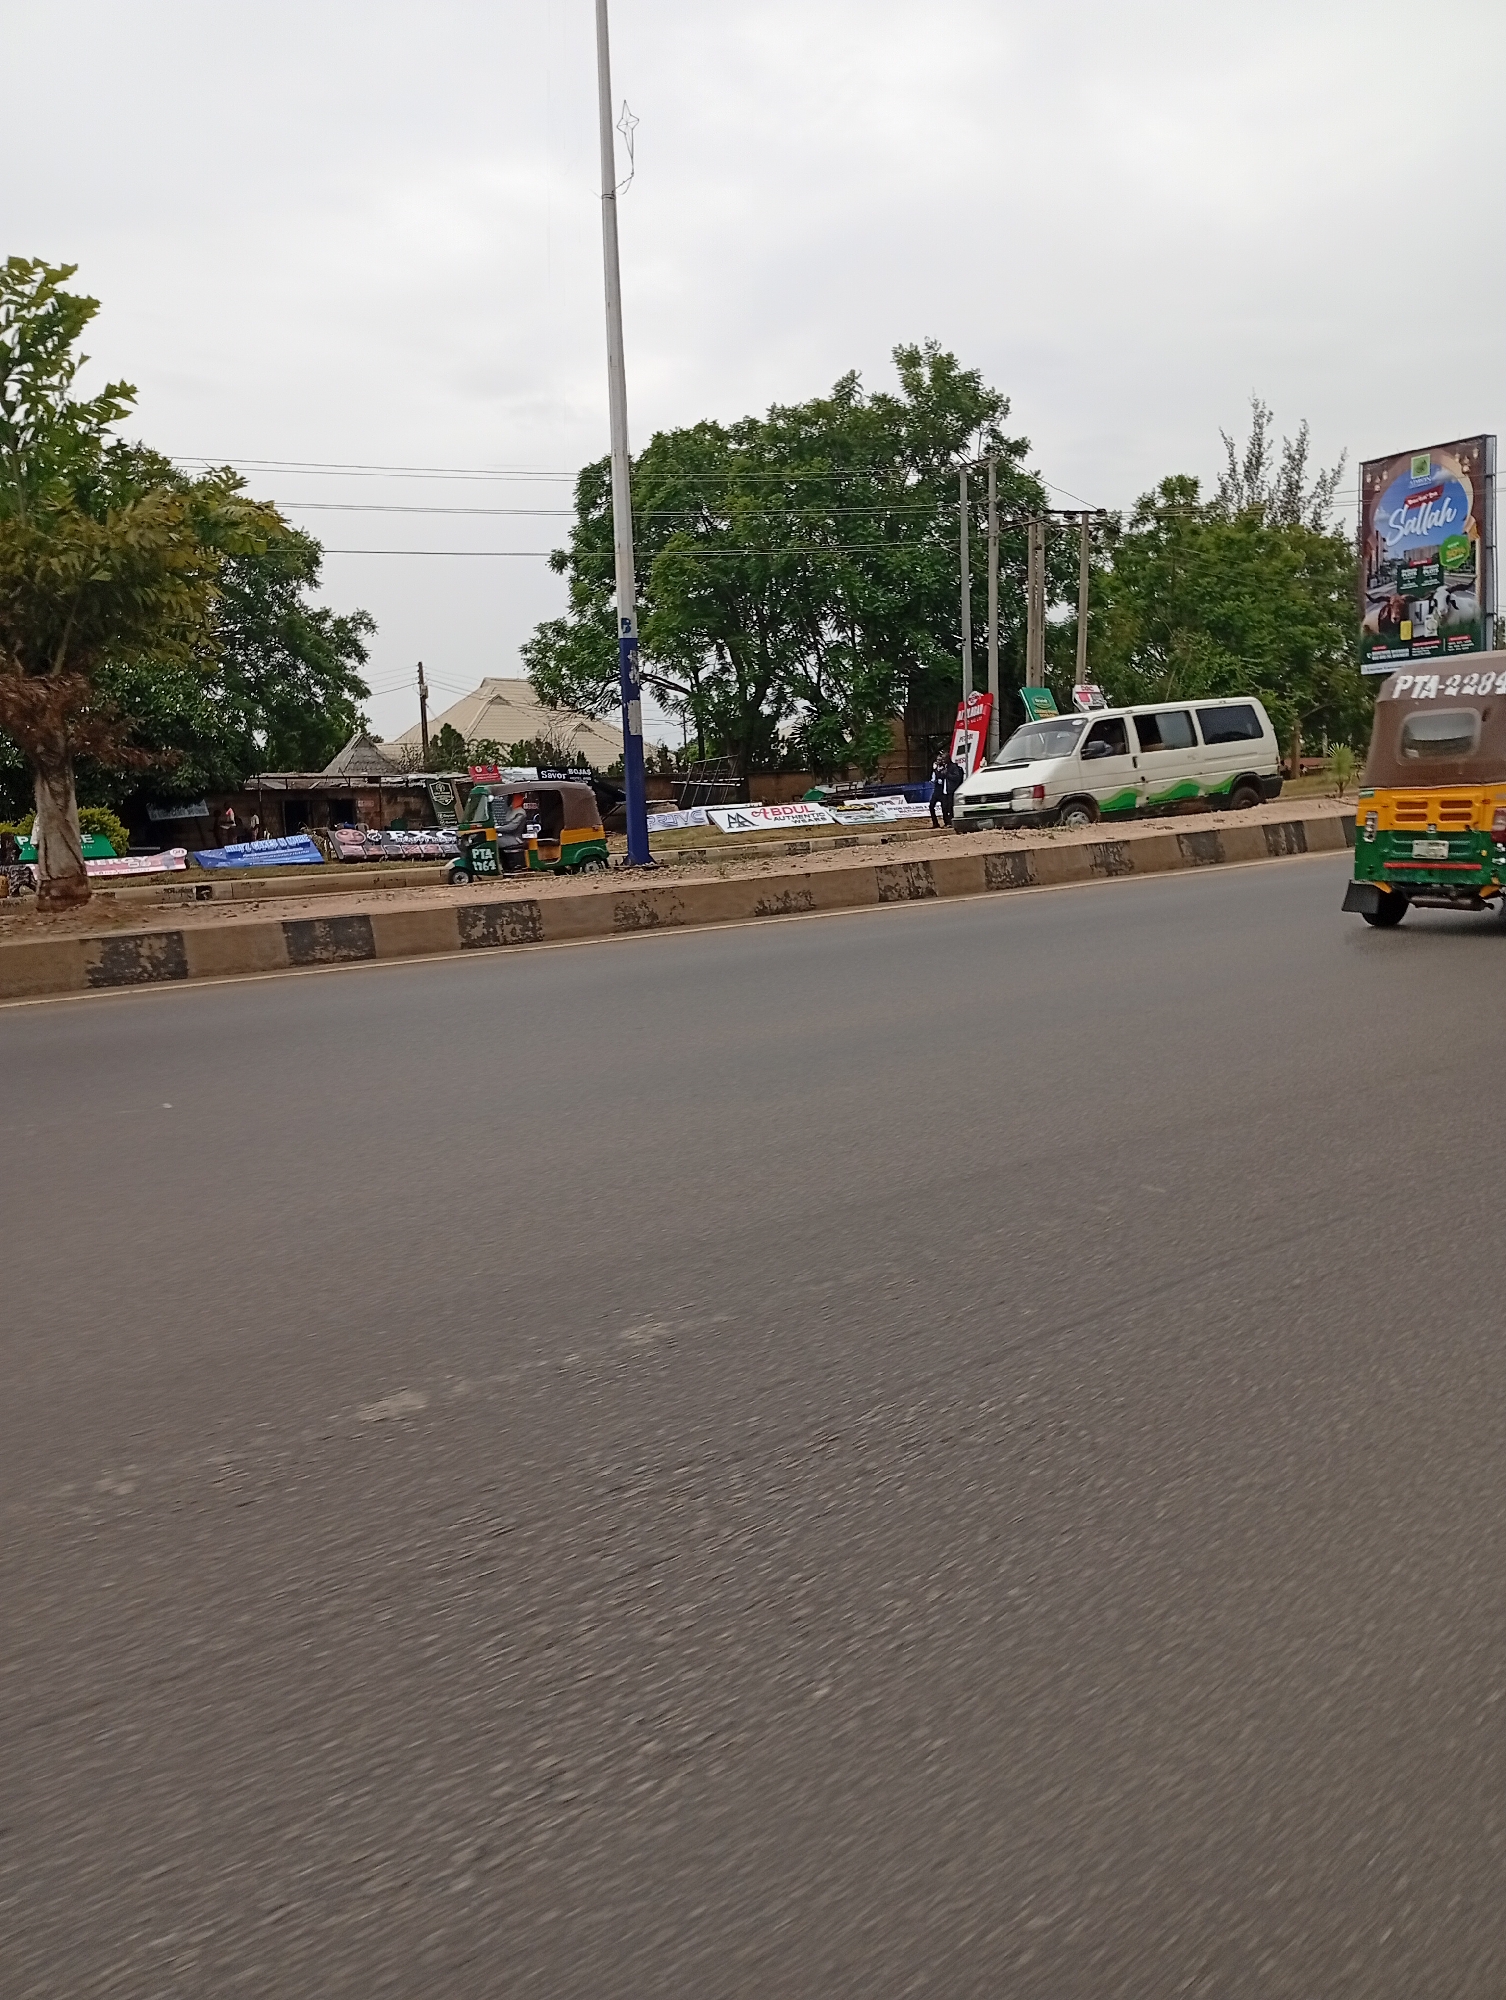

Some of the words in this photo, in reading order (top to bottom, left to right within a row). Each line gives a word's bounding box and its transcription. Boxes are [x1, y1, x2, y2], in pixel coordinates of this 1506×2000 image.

[1386, 496, 1457, 547] Sallah
[541, 770, 567, 779] Savor
[751, 805, 816, 820] ABDUL
[774, 812, 826, 821] AUTHENTIC
[791, 816, 827, 824] WEARS
[386, 828, 456, 840] EXC
[84, 856, 148, 867] NERGY
